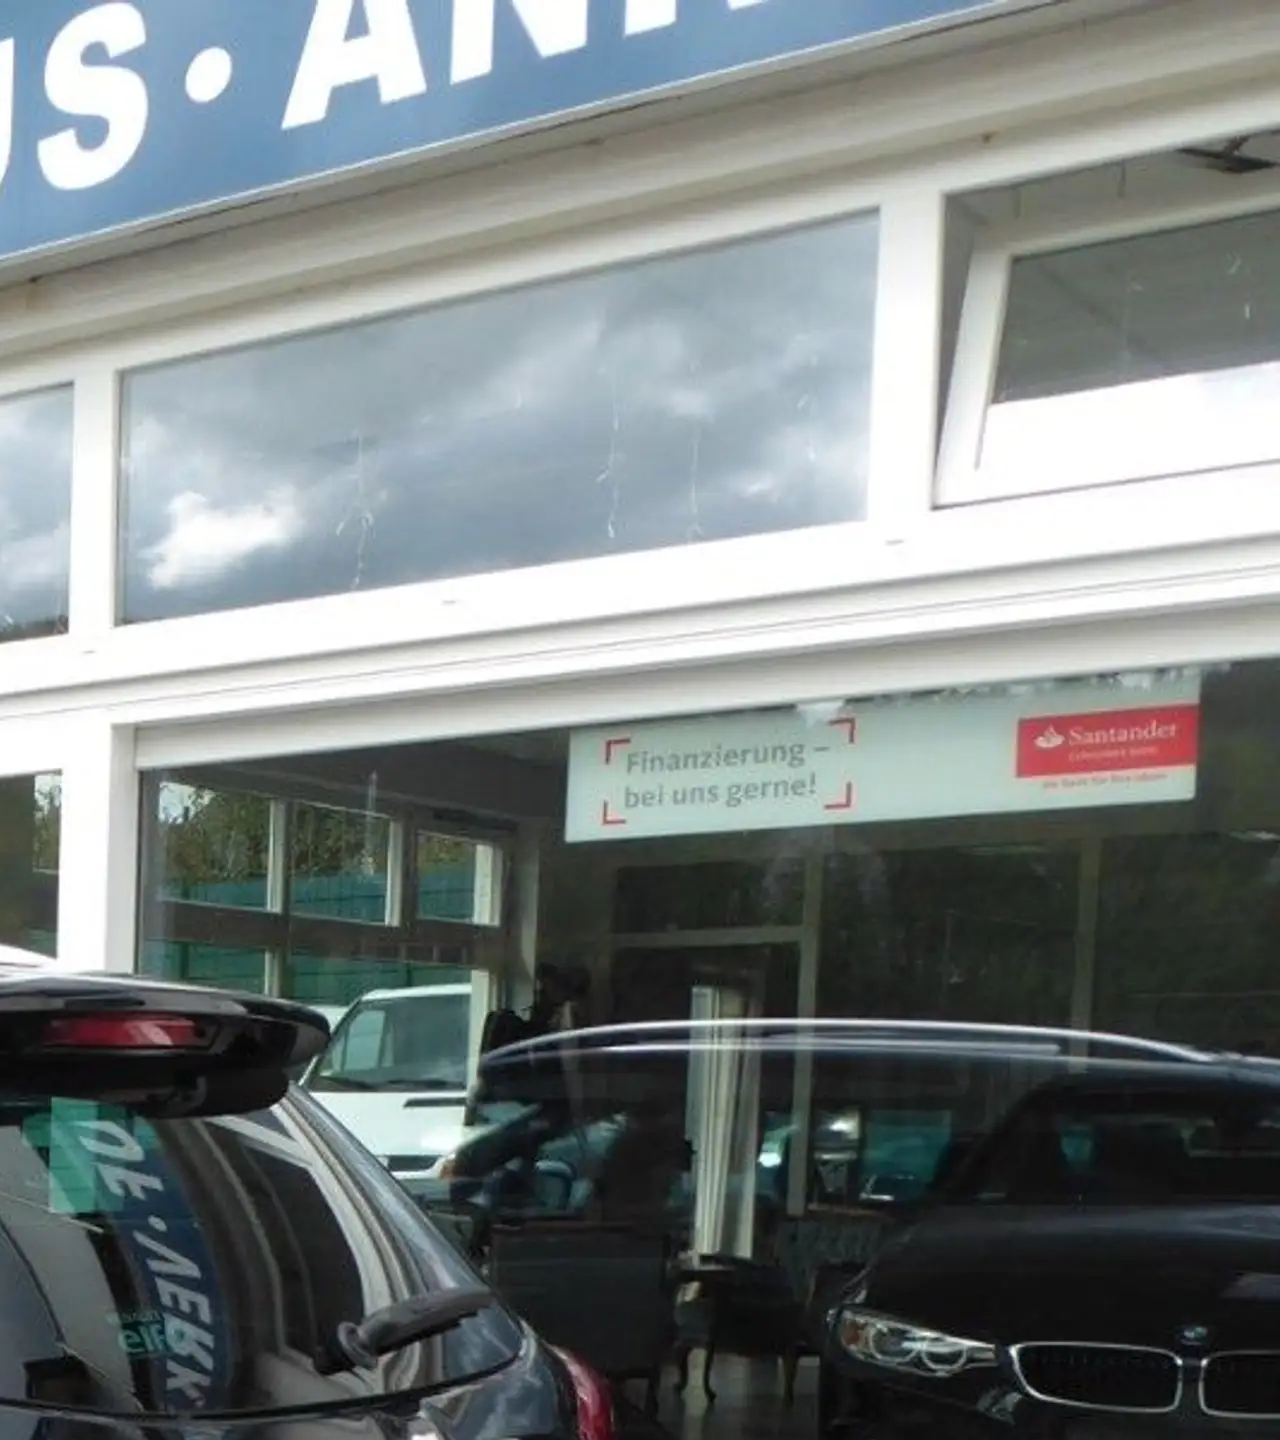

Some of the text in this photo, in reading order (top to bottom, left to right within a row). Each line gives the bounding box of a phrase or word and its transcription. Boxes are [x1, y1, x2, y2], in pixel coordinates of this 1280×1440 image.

[1068, 719, 1178, 747] Santander
[626, 743, 806, 775] Finanzierung
[624, 771, 817, 808] bei uns gerne!
